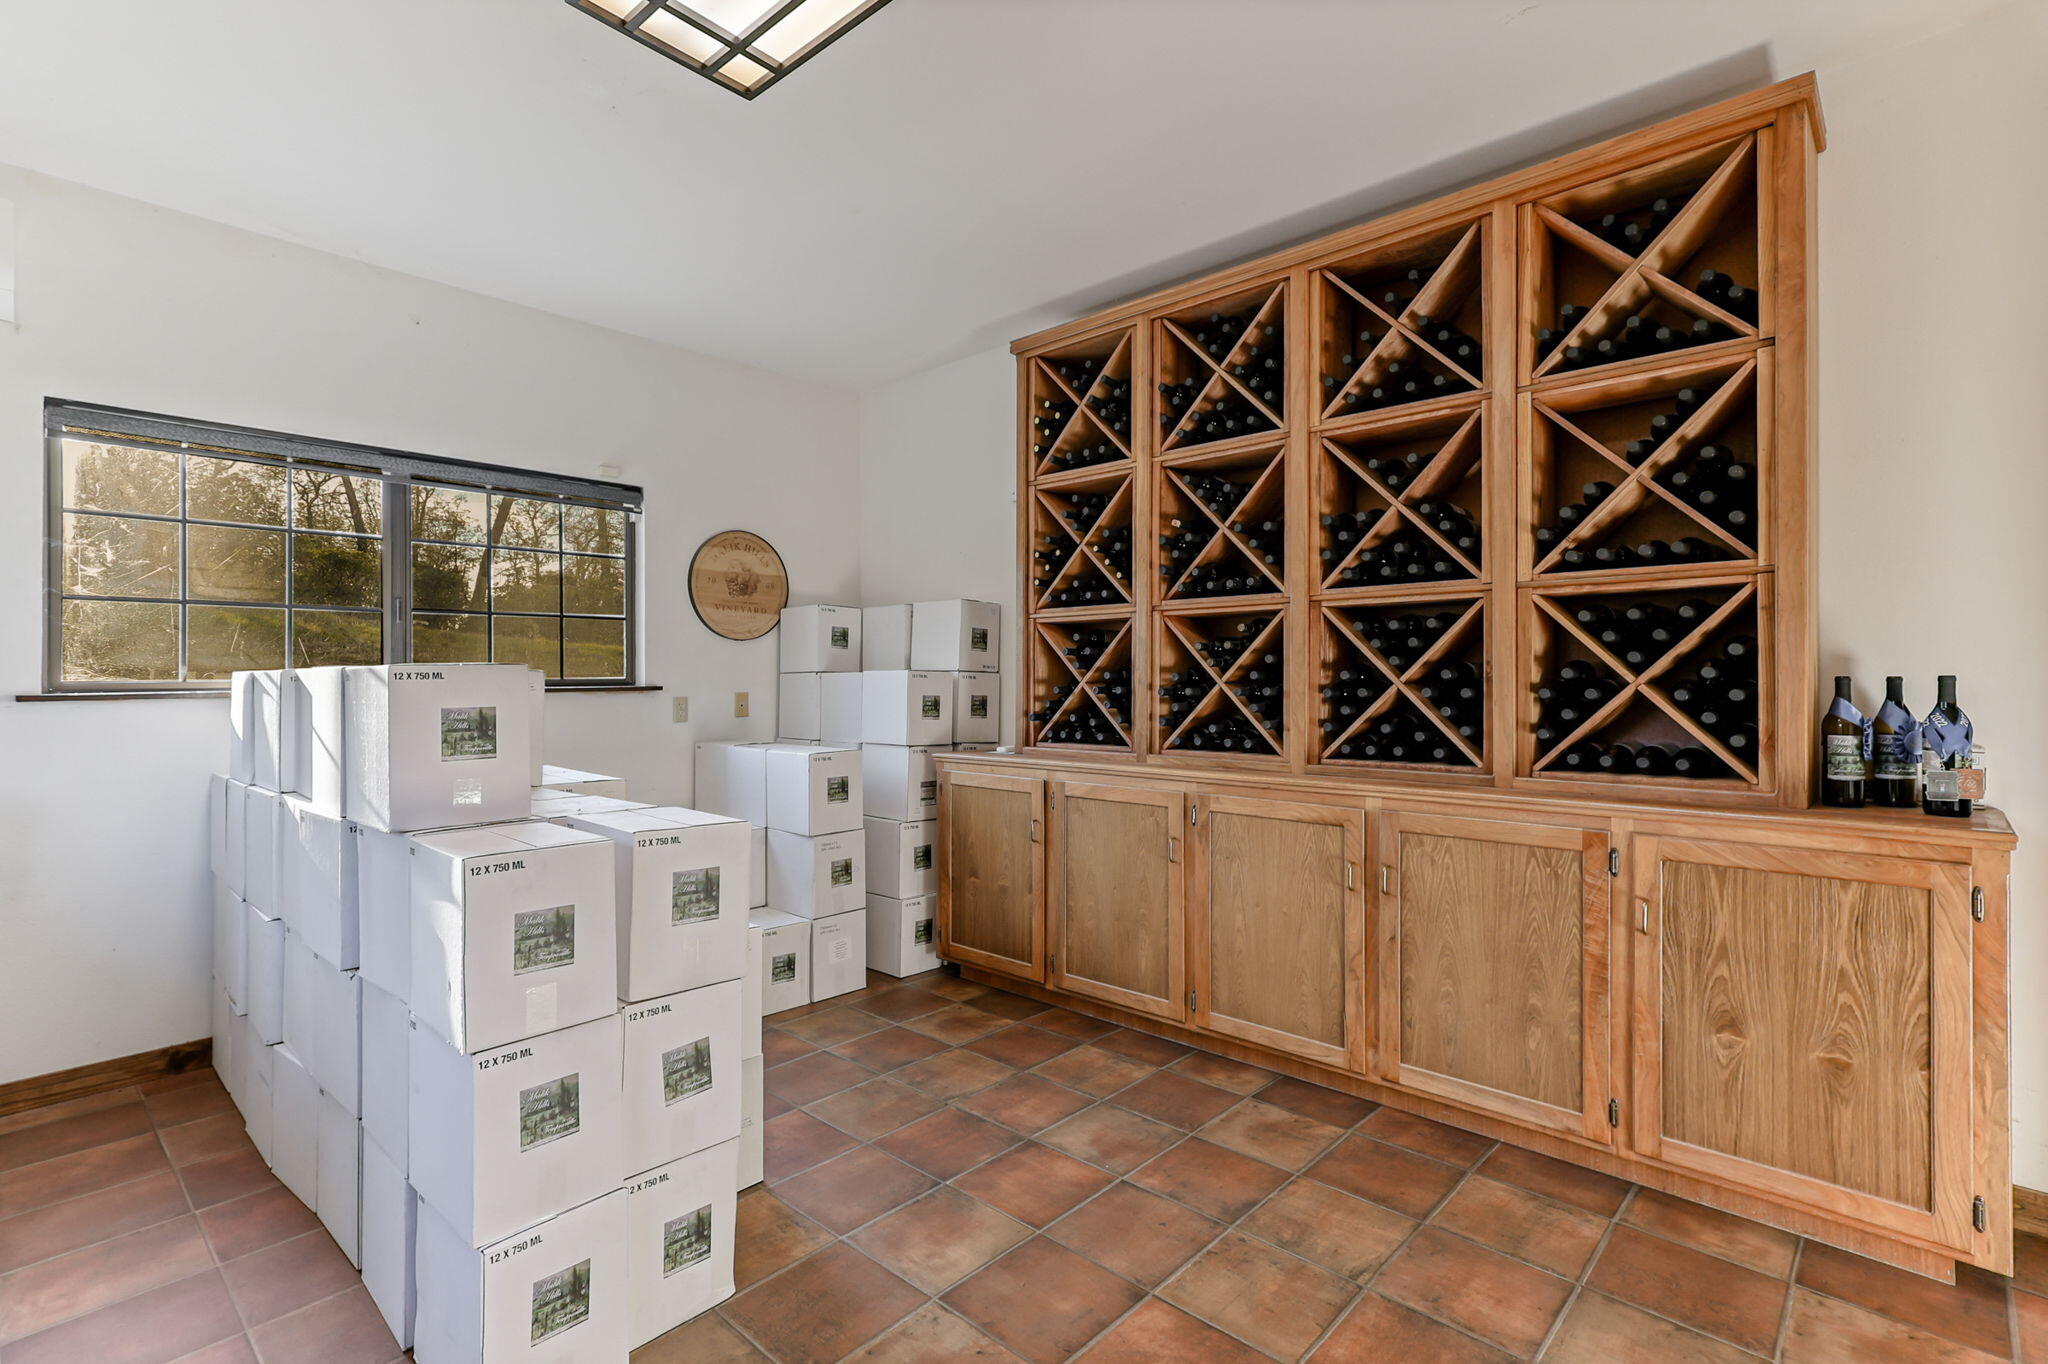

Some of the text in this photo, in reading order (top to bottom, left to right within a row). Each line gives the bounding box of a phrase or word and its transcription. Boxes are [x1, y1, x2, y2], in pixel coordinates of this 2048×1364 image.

[715, 603, 767, 614] VINEYARD
[393, 672, 445, 680] 12 X 750 ML
[447, 711, 470, 720] Malik
[1930, 712, 1949, 728] 2022
[449, 720, 469, 729] Hills
[638, 836, 682, 848] 12 X 750 ML
[470, 860, 526, 877] 12 X 750 ML
[520, 915, 545, 927] Malik
[525, 926, 545, 937] Hills
[628, 1004, 672, 1022] 12 X 750 ML
[479, 1047, 533, 1070] 12 X 750 ML
[528, 1099, 550, 1113] Hills
[637, 1183, 642, 1191] X
[643, 1177, 658, 1189] 750
[658, 1172, 670, 1183] ML
[490, 1234, 544, 1264] 12 X 750 ML
[541, 1288, 562, 1304] Hills
